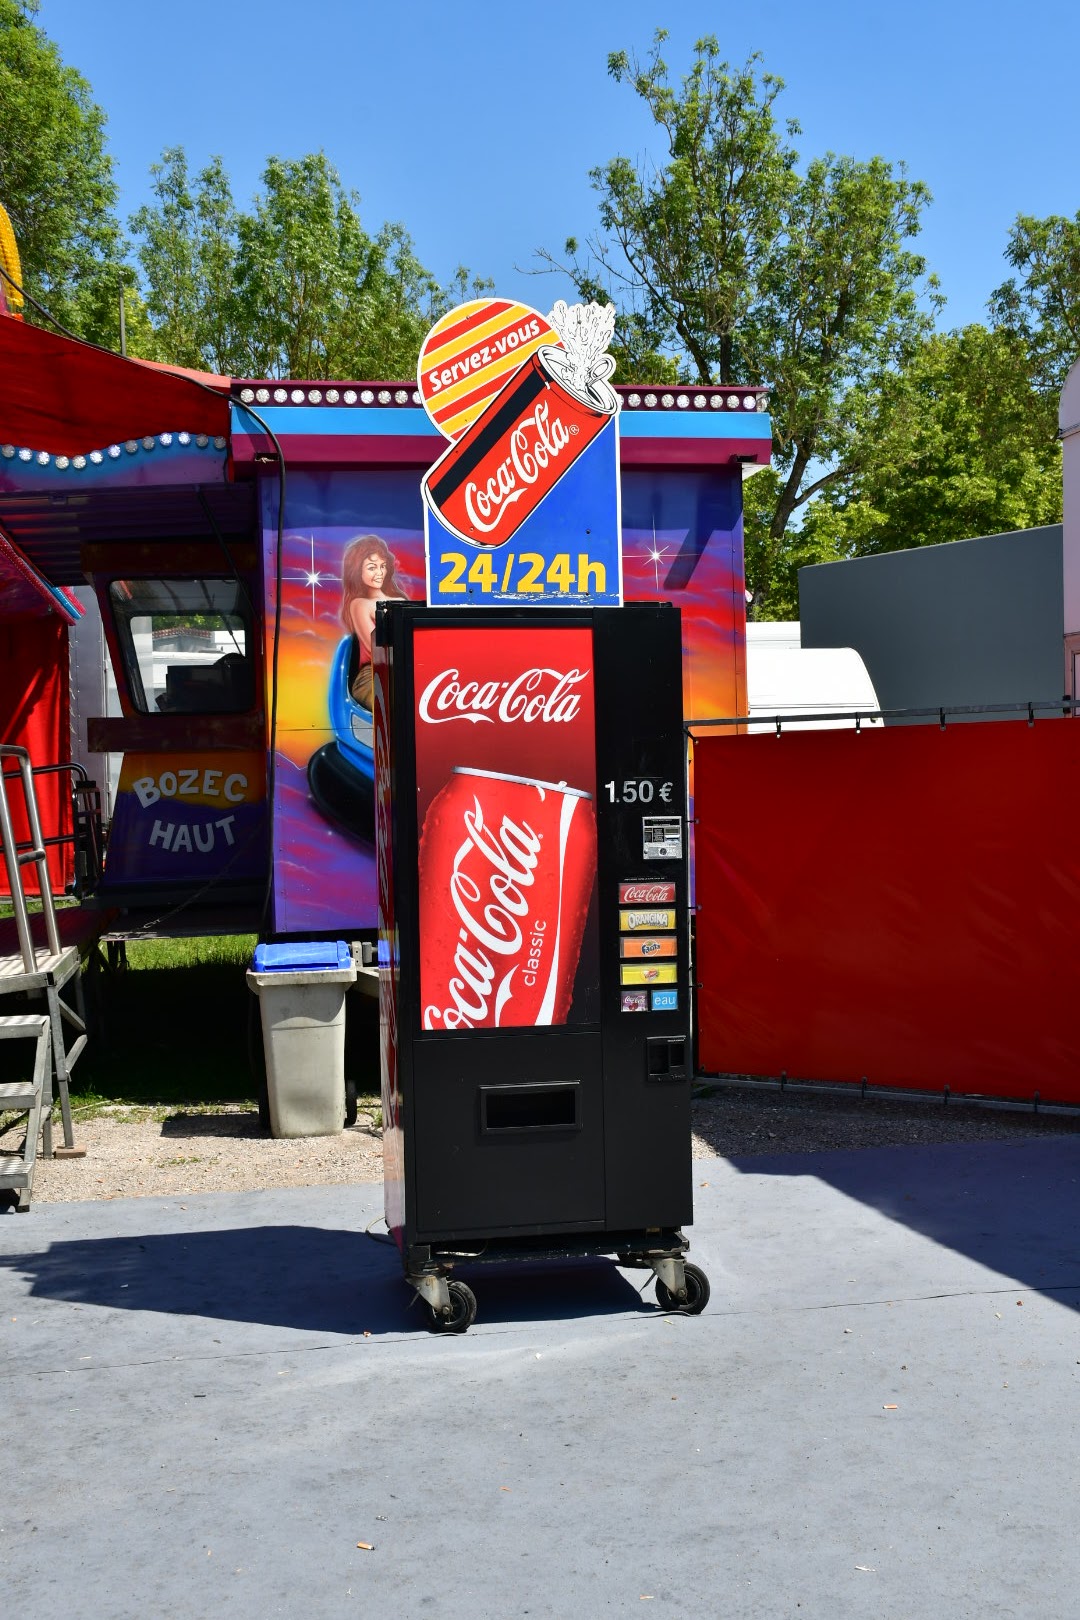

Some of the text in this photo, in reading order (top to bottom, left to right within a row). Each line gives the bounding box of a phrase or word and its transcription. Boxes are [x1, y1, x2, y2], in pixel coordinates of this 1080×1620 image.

[429, 318, 540, 393] Servez-vous
[464, 400, 570, 533] Coca-Cola
[438, 552, 607, 594] 24/24h
[418, 667, 591, 724] Coca-Cola
[132, 769, 248, 809] BOZEC
[604, 780, 674, 803] 1.50 €
[148, 814, 236, 853] HAUT
[623, 885, 671, 902] Coca-Cola
[628, 912, 668, 929] ORANGINA
[521, 919, 547, 987] classic
[654, 996, 676, 1005] eau
